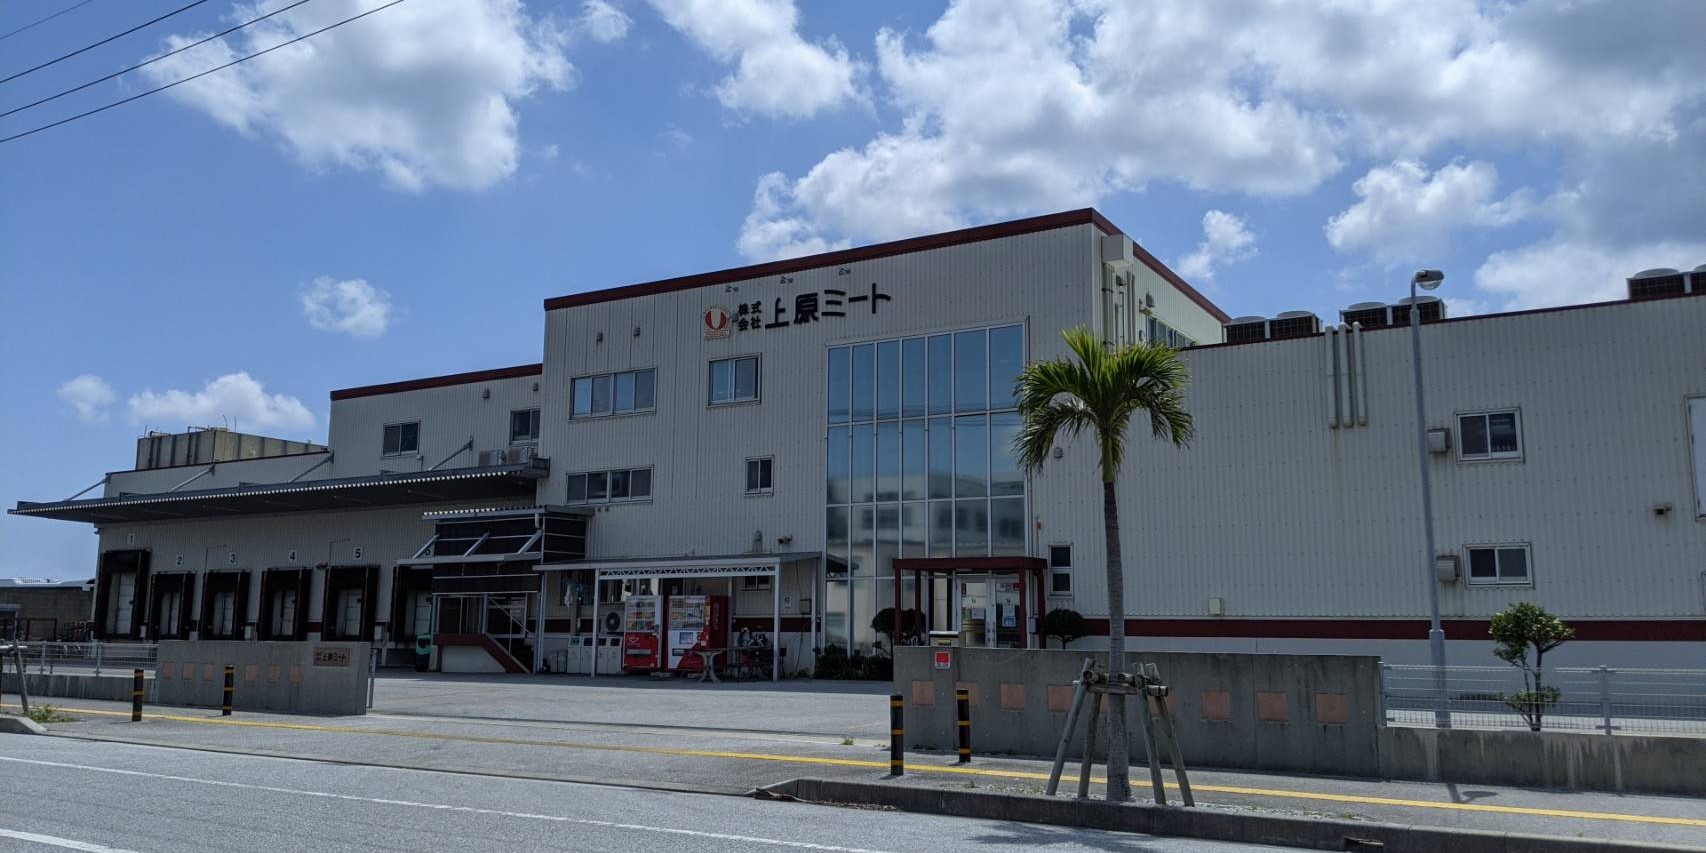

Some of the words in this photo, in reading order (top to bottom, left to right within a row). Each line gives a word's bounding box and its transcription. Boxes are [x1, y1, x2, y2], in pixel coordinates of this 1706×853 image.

[738, 301, 762, 316] 株式
[765, 283, 892, 329] 上原ミート
[738, 316, 762, 331] 会社
[289, 551, 296, 561] 4
[354, 548, 361, 558] 5
[176, 556, 183, 565] 2
[230, 554, 236, 563] 3
